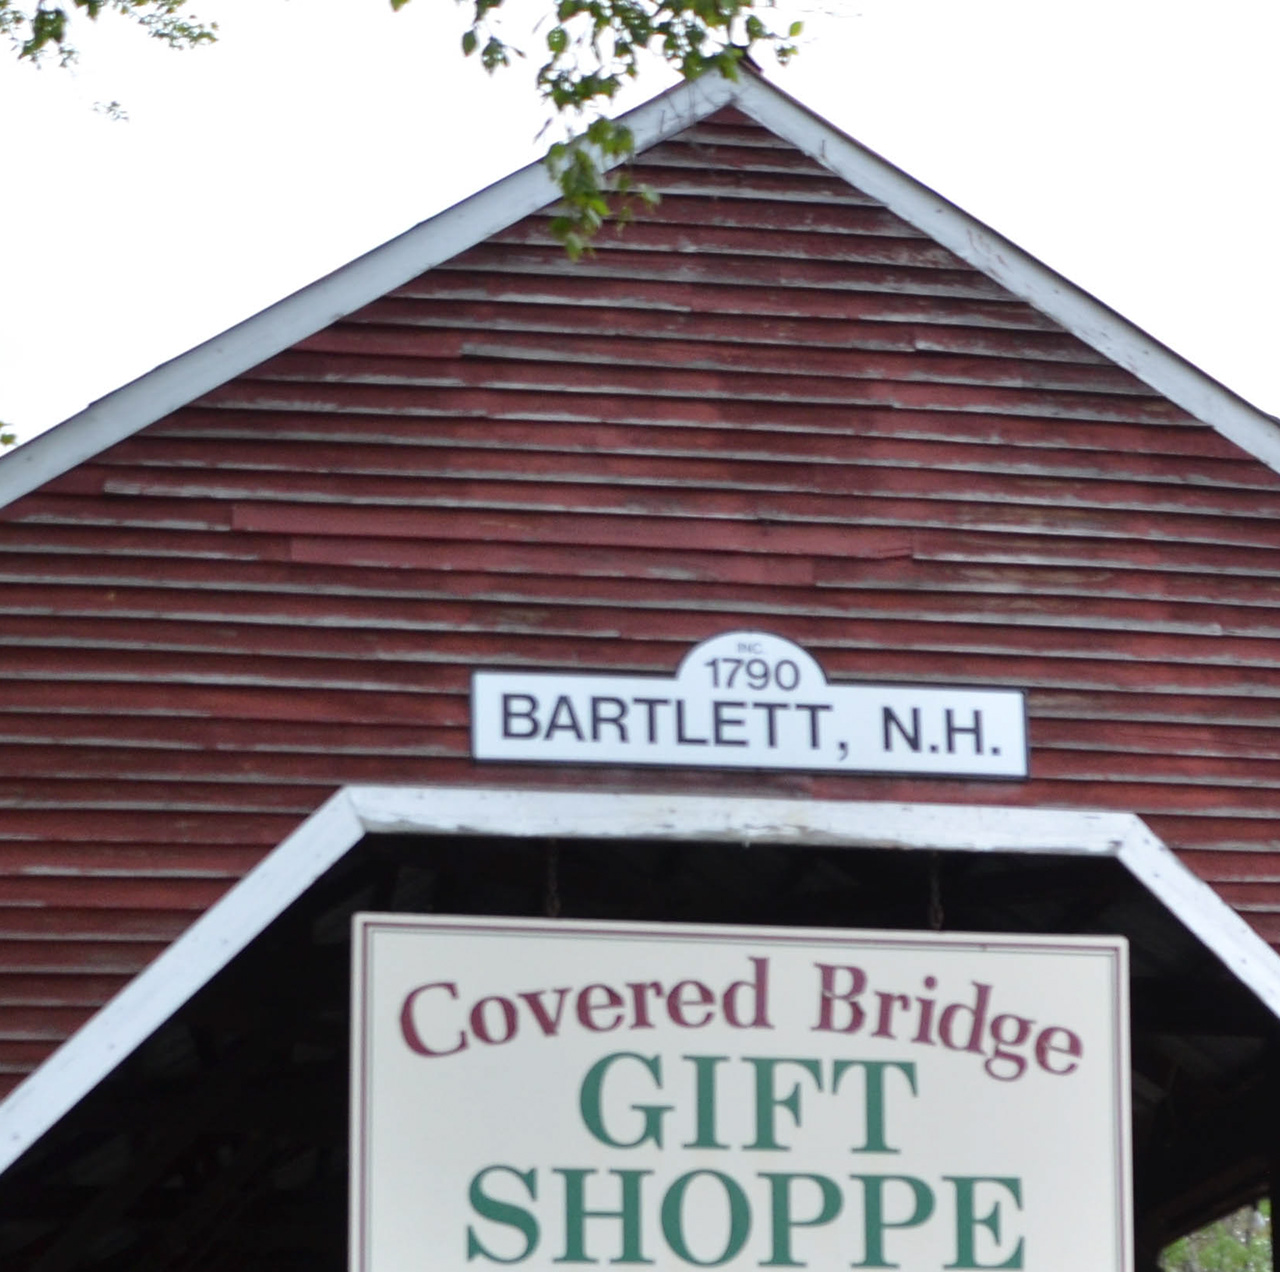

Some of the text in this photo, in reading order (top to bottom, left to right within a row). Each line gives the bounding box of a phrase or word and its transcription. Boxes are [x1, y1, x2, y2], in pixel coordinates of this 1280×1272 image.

[501, 692, 1003, 761] BARTLETT, N.H.
[703, 657, 800, 692] 1790
[399, 956, 1084, 1082] Covered Bridge
[577, 1051, 919, 1155] GIFT
[465, 1164, 1026, 1272] SHOPPE
